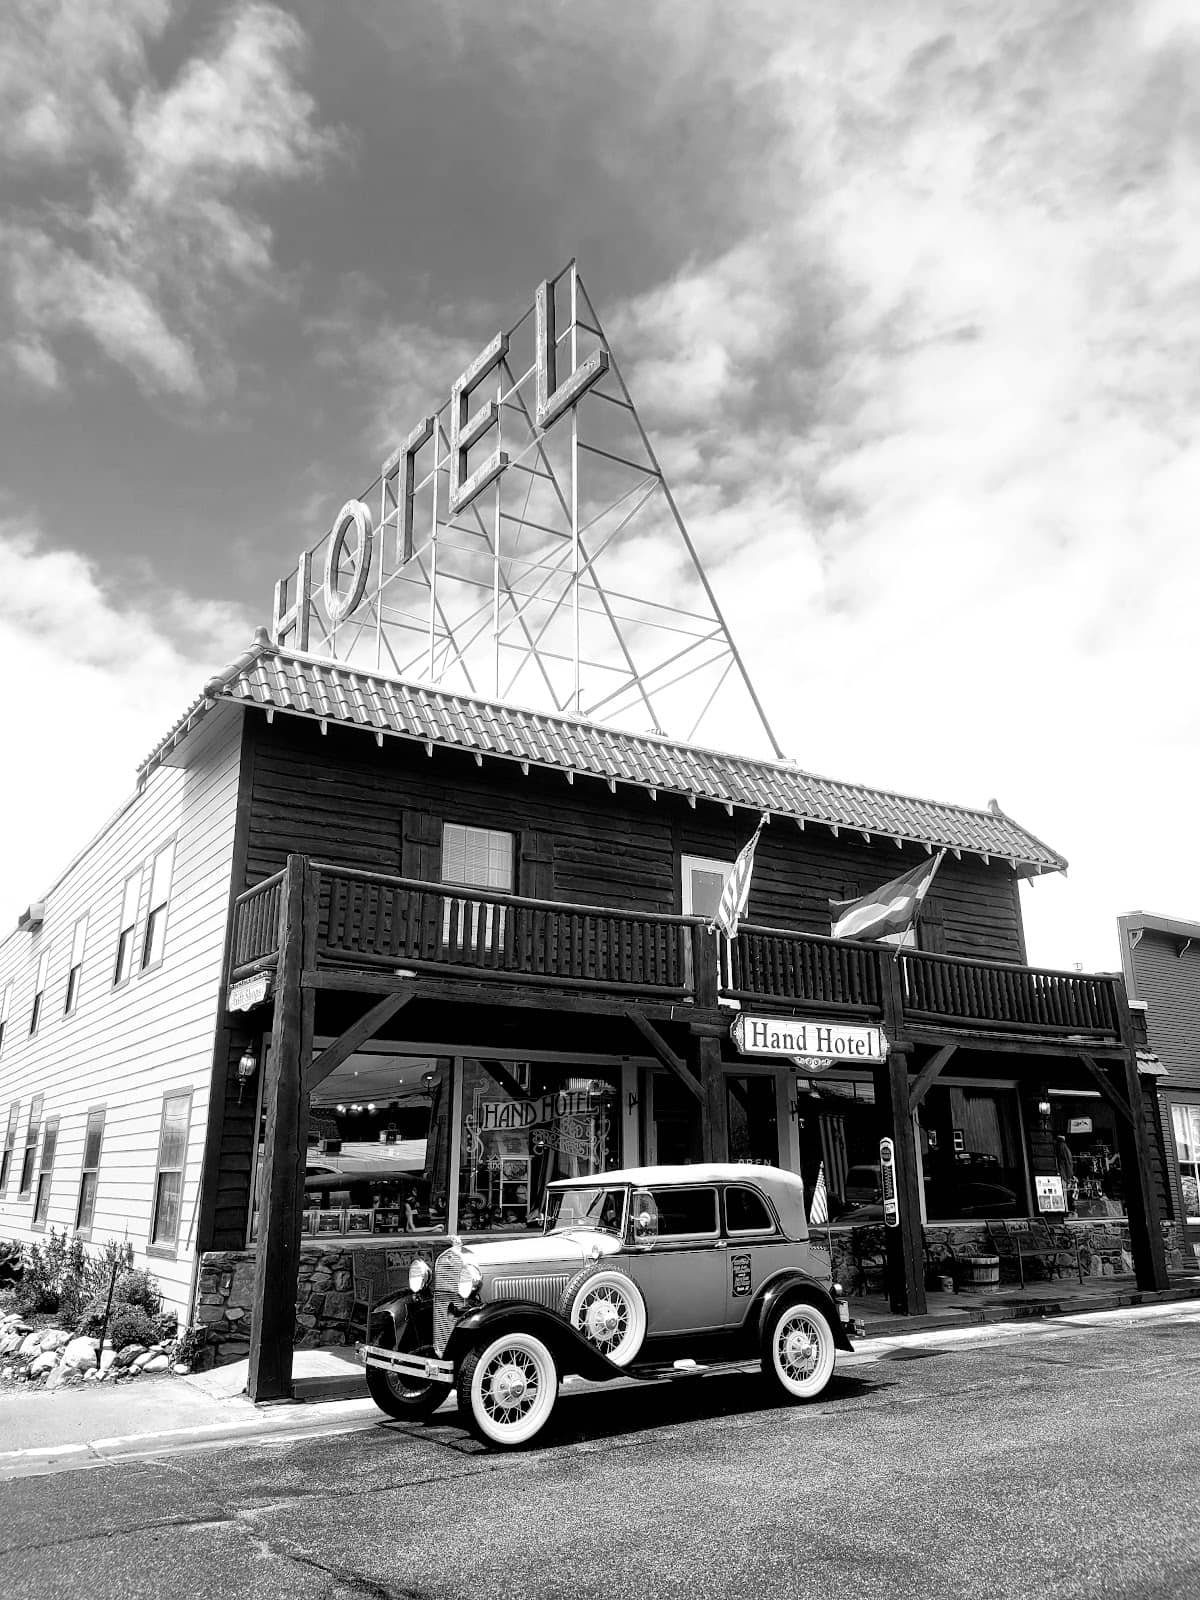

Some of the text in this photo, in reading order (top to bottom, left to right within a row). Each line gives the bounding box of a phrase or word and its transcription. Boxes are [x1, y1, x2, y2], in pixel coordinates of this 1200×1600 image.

[273, 279, 609, 652] HOTEL
[751, 1021, 873, 1056] Hand Hotel
[484, 1091, 598, 1129] HAND HOTEL
